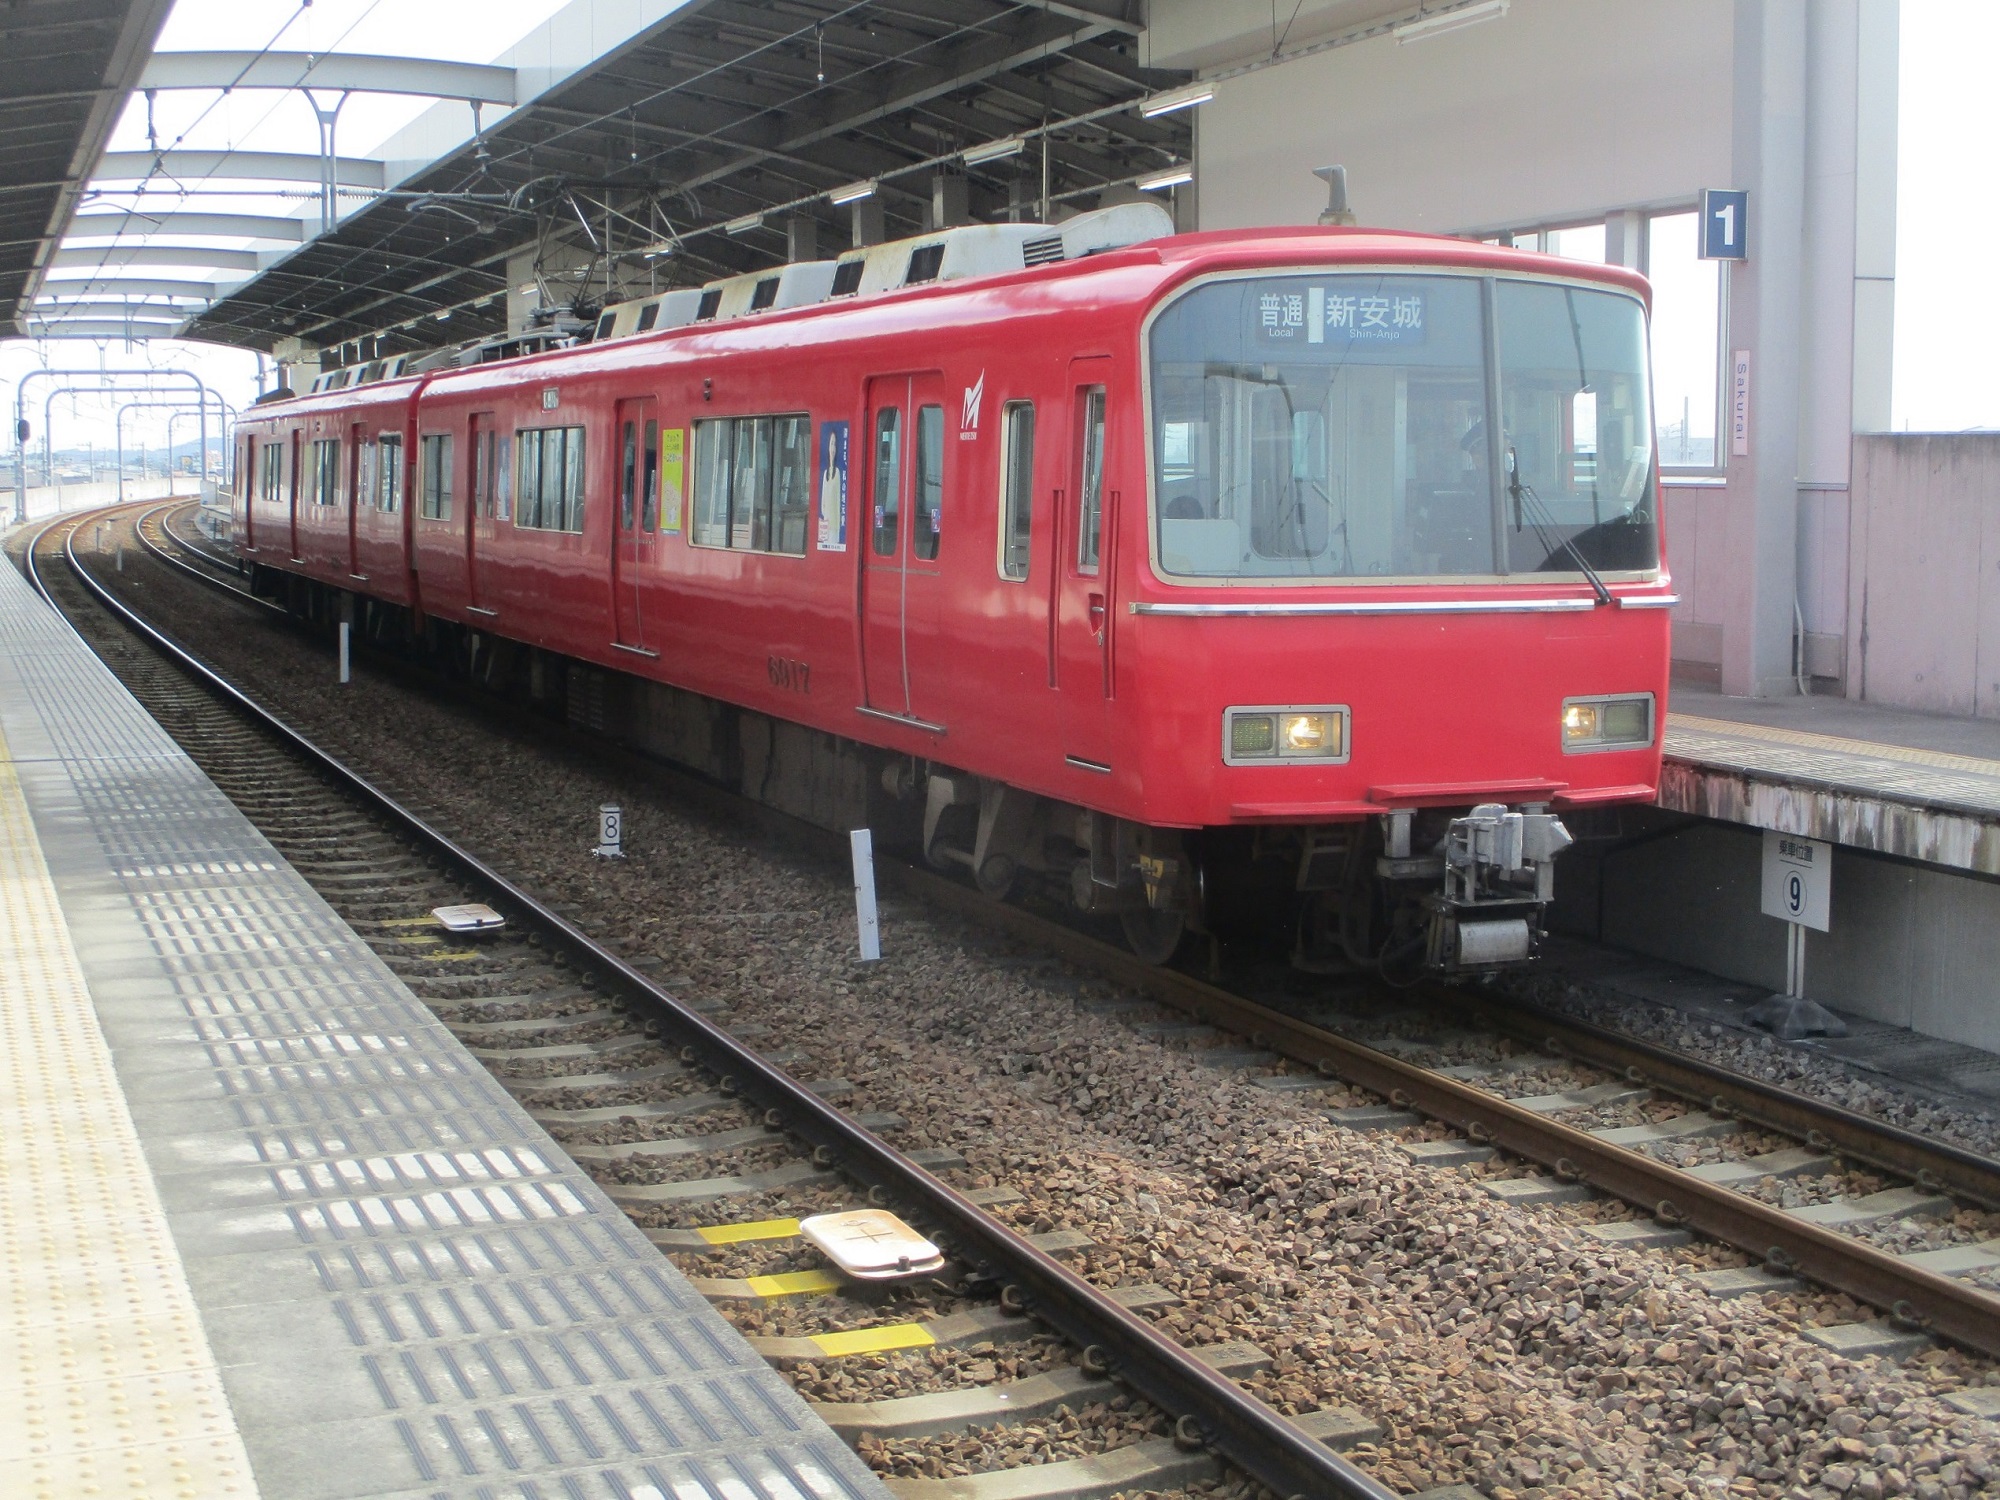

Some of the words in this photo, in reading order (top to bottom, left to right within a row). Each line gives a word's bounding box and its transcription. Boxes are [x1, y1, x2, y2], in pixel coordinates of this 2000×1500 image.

[1715, 205, 1734, 246] 1
[1259, 293, 1303, 327] 普通
[1326, 294, 1422, 329] 新安城
[1269, 328, 1294, 337] Local
[1349, 329, 1400, 340] Shin-Anjo
[1736, 363, 1746, 440] Sakurai
[604, 815, 618, 838] 8
[1790, 876, 1800, 911] 9
